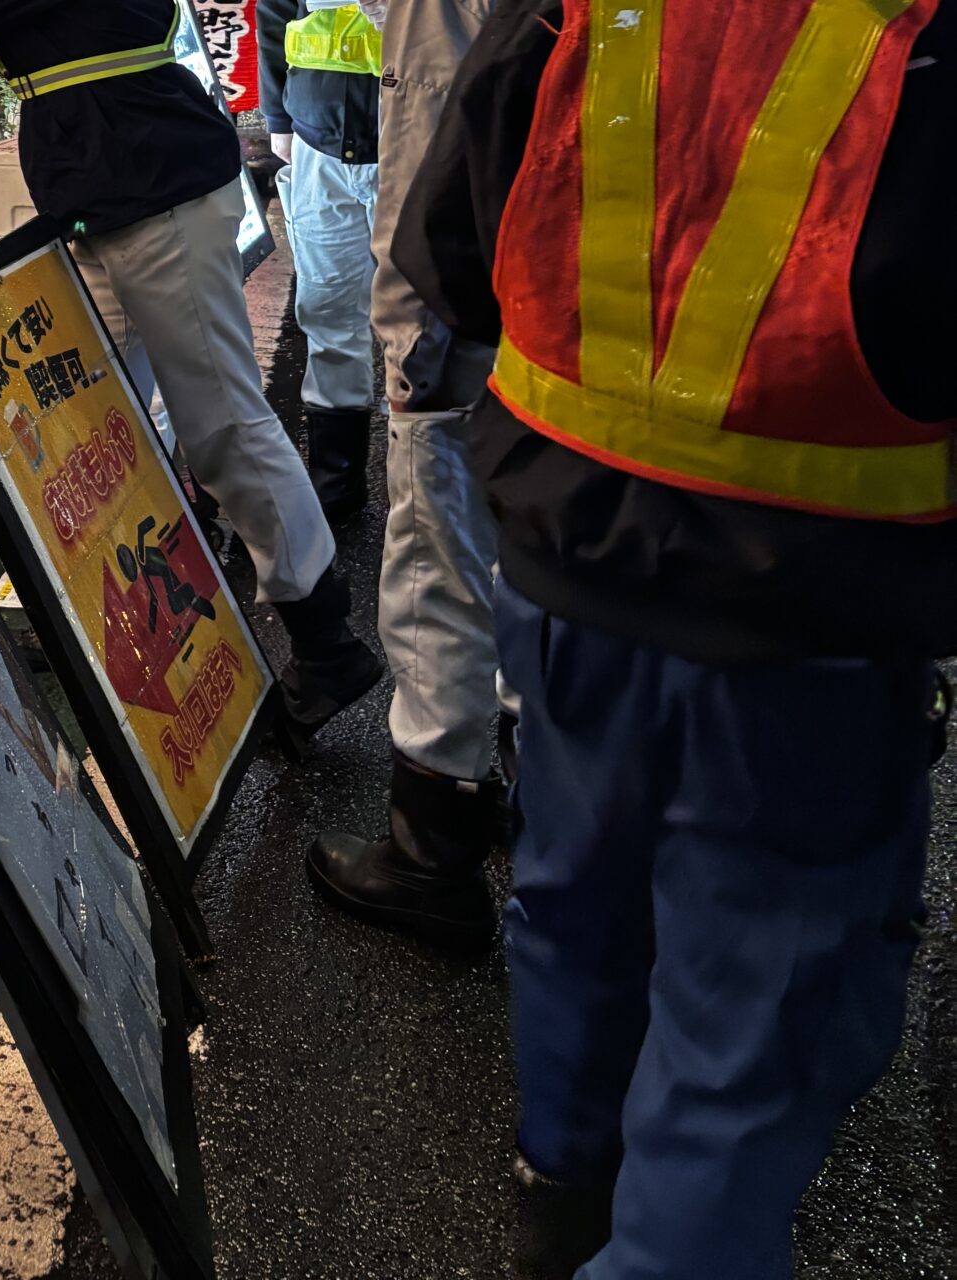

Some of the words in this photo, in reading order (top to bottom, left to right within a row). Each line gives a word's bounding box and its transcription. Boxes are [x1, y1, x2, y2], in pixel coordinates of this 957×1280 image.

[44, 409, 135, 540] あげもんや
[161, 640, 240, 781] 入り口は左へ
